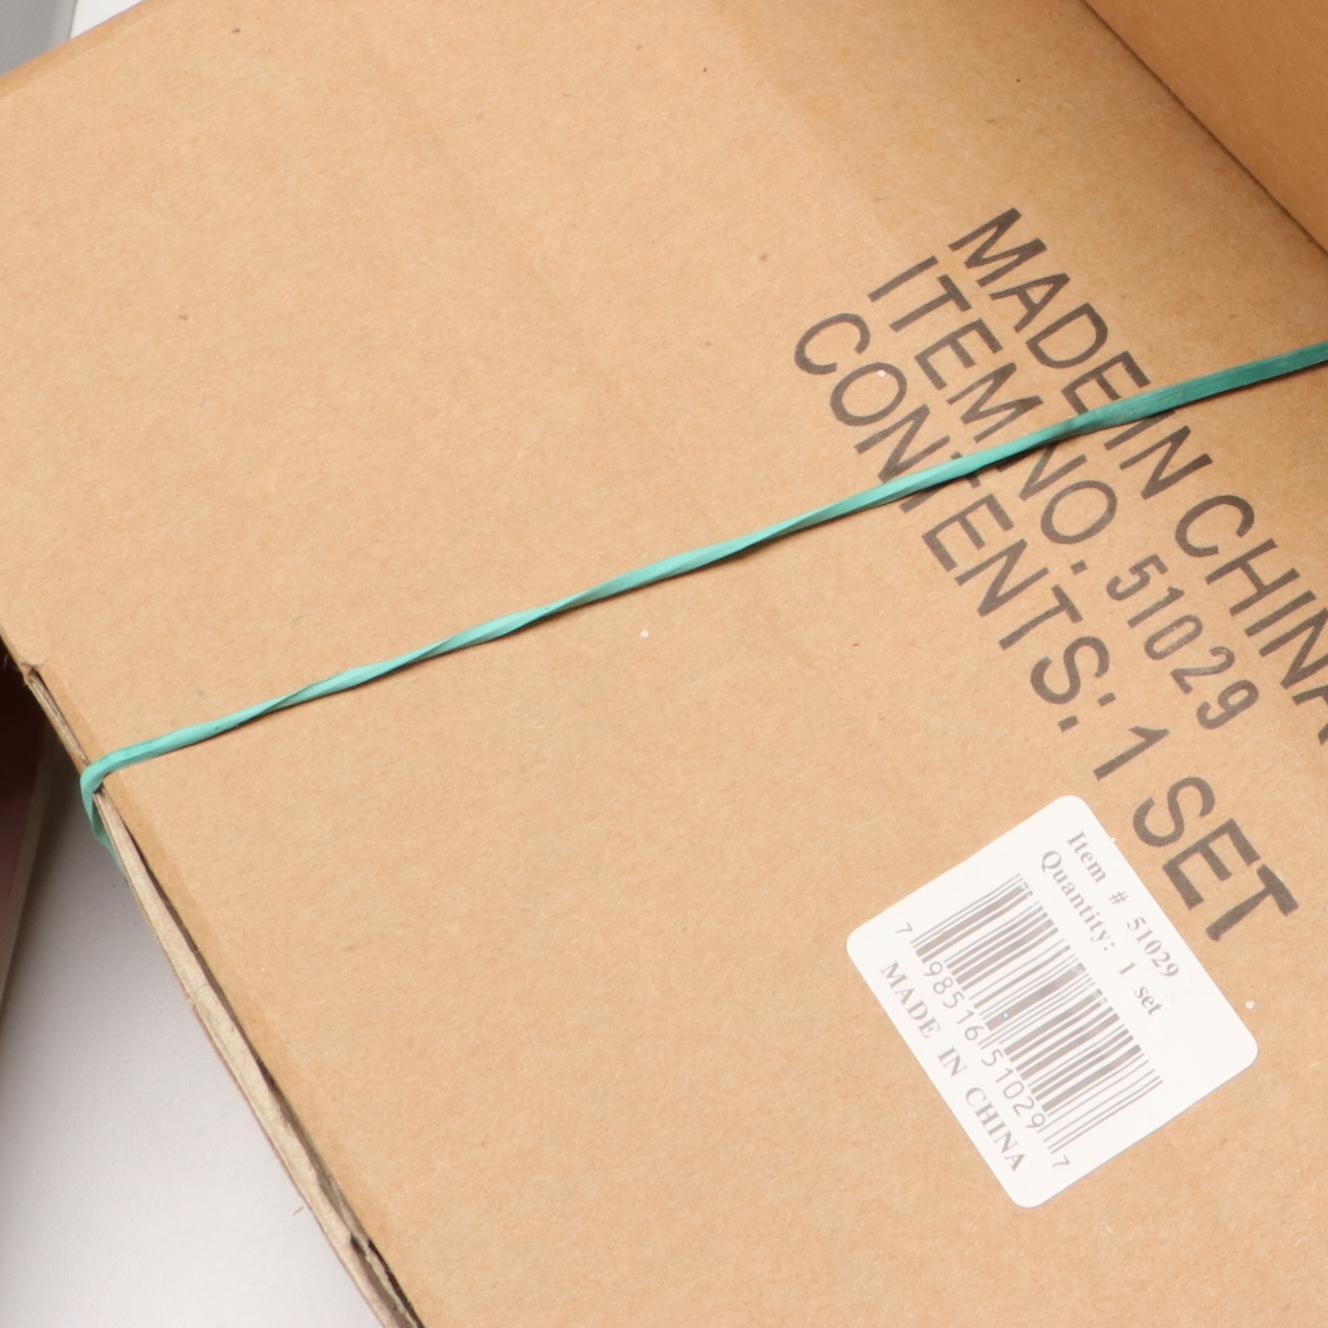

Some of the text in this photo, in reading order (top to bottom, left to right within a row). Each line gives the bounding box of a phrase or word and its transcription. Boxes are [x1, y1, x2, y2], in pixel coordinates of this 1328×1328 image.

[947, 207, 1152, 417] MADE
[1104, 409, 1213, 500] IN
[867, 255, 1260, 731] ITEM NO. 51029
[1041, 850, 1164, 1016] Quantity: 1 set
[1066, 831, 1180, 979] Item # 51029
[1093, 725, 1170, 781] 1
[1132, 776, 1299, 942] SET
[880, 962, 1029, 1172] MADE IN CHINA
[927, 960, 983, 1042] 98516
[981, 1048, 1047, 1132] 51029
